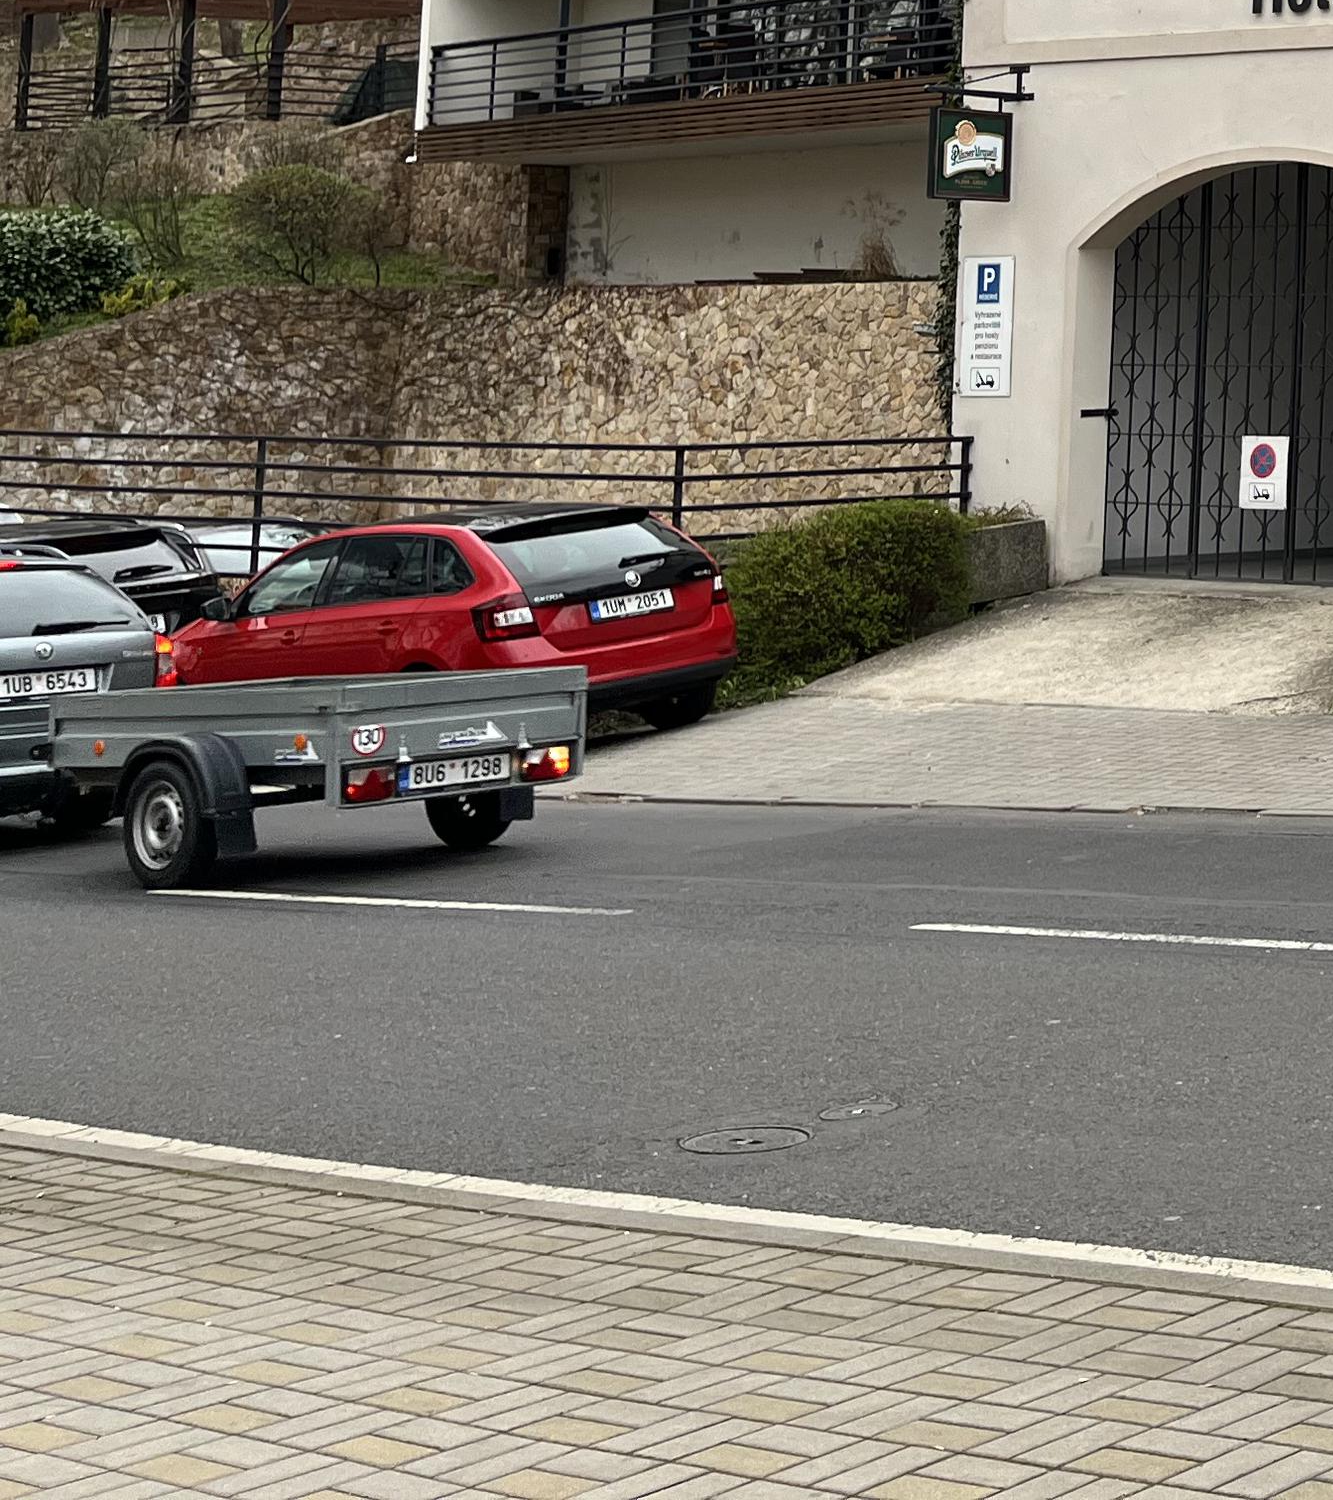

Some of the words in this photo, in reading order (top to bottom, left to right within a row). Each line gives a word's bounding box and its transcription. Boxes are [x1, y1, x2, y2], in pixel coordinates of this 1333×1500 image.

[983, 267, 996, 292] P
[602, 598, 627, 614] 1UM
[637, 591, 668, 610] 2051
[2, 676, 33, 694] 1UB
[46, 672, 87, 690] 6543
[358, 728, 380, 746] 130
[413, 764, 446, 784] 8U6
[461, 758, 502, 779] 1298
